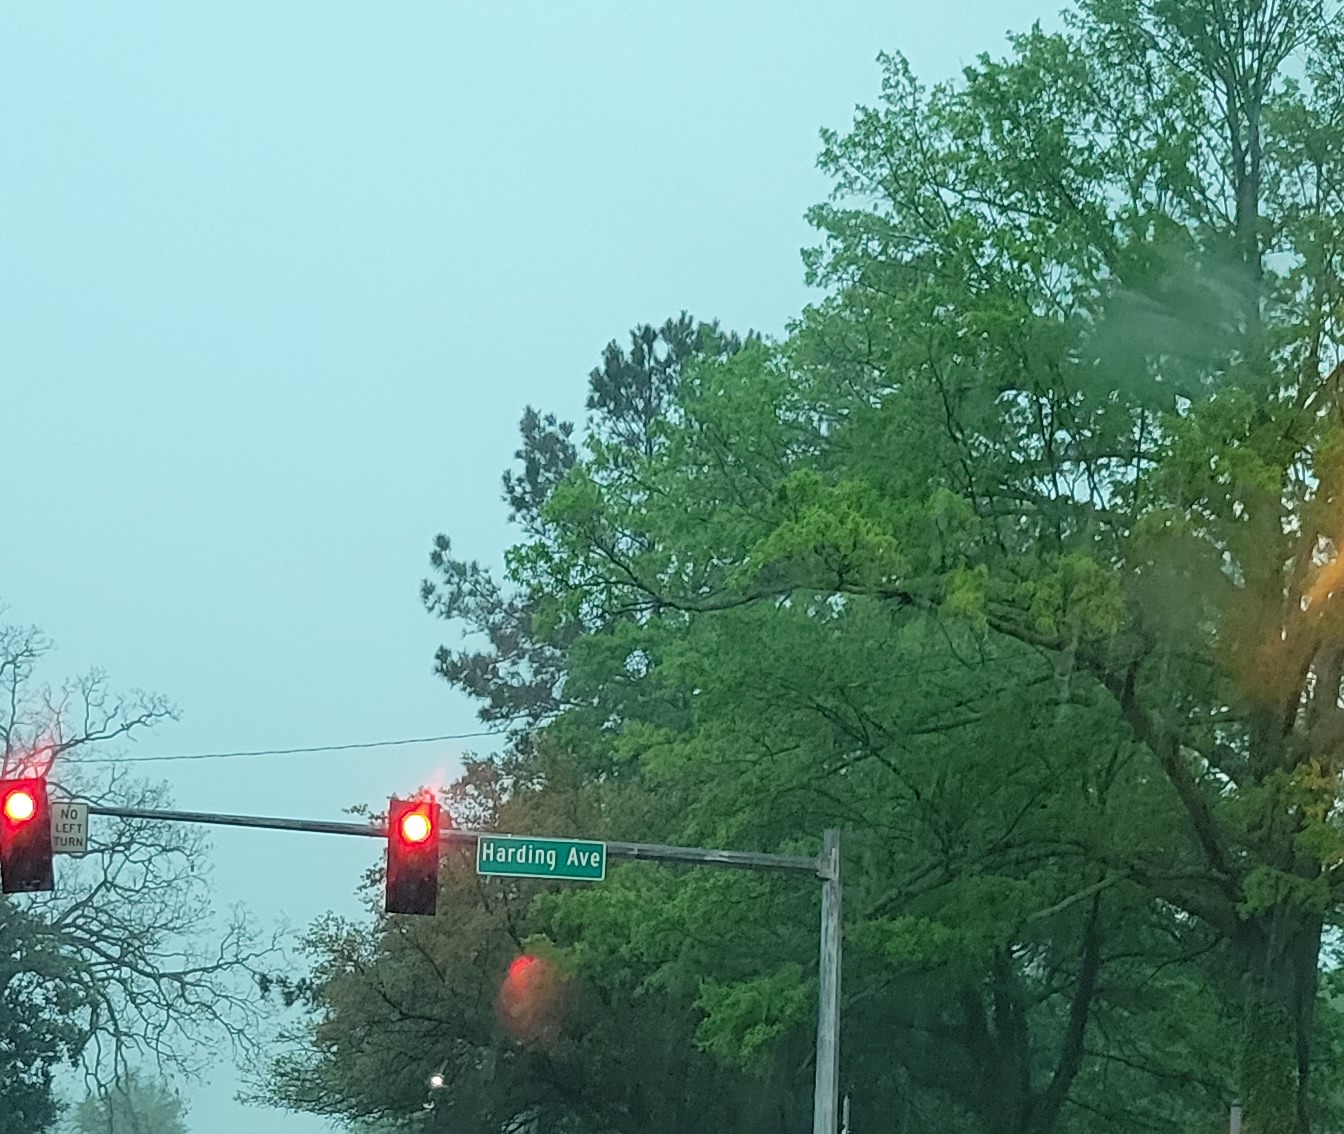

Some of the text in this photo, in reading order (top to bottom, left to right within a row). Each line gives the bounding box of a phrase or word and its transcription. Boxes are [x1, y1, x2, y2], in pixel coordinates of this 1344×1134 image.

[60, 808, 78, 820] NO
[56, 823, 82, 834] LEFT
[54, 836, 83, 847] TURN
[482, 842, 600, 871] Harding Ave
